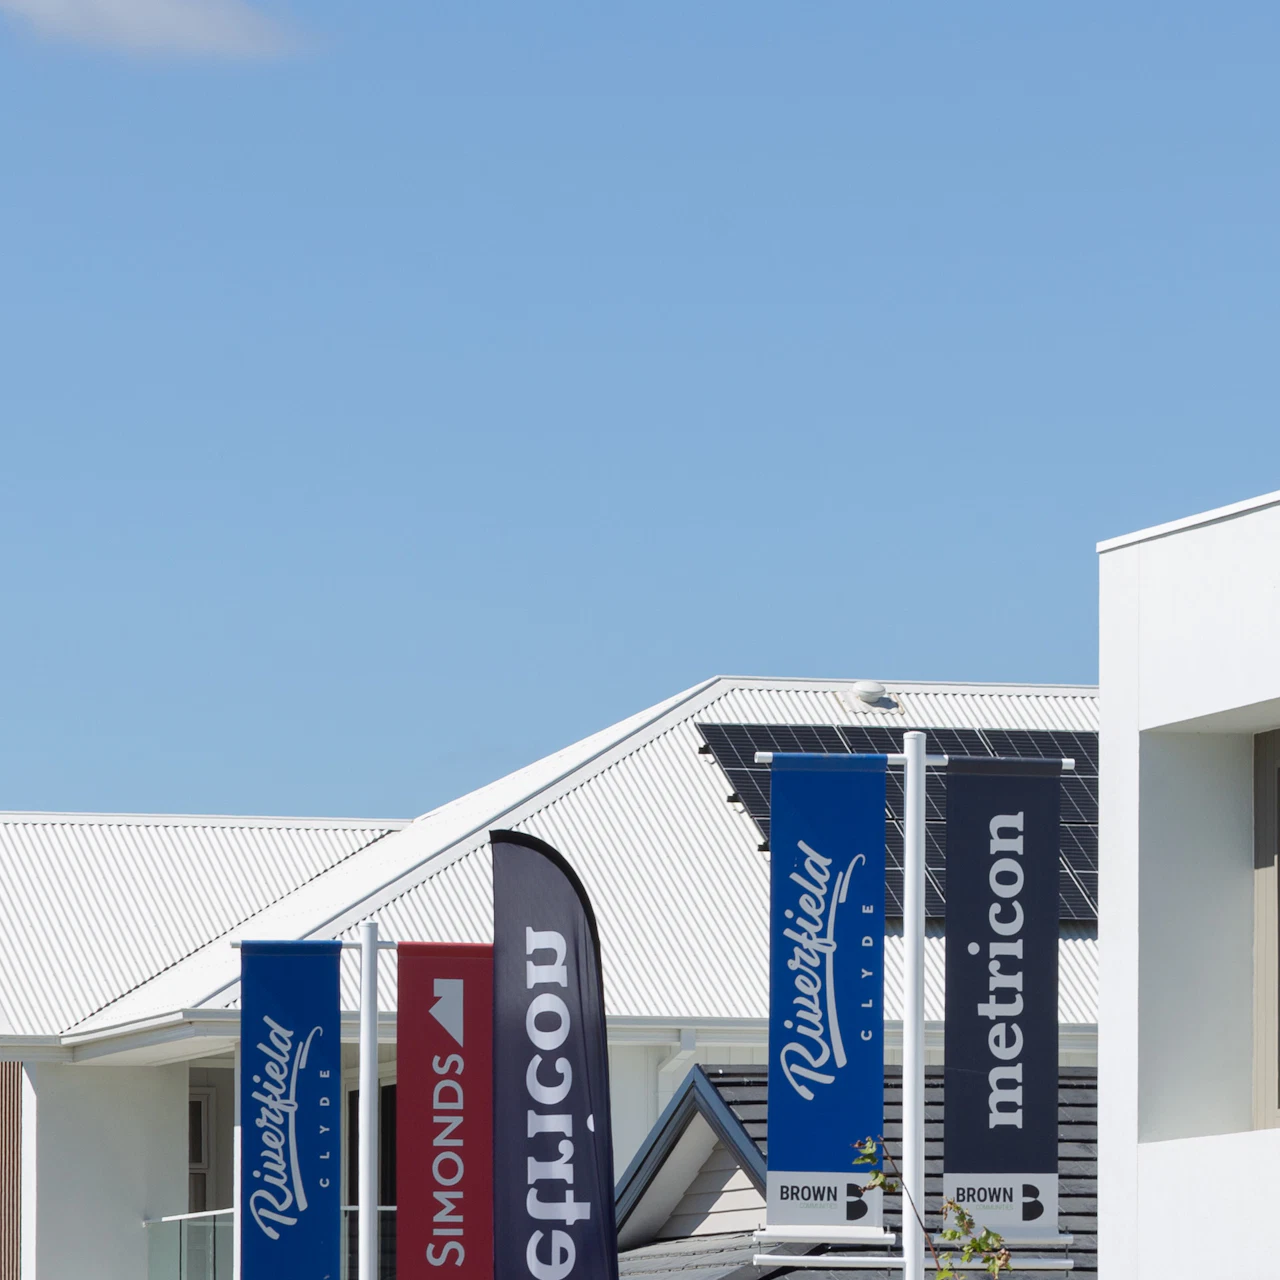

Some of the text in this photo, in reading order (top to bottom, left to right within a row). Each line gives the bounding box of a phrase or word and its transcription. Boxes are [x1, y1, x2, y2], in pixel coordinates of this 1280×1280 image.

[779, 839, 841, 1101] Riverfield
[860, 904, 874, 1041] CLYDE
[968, 811, 1025, 1129] metricon
[250, 1015, 305, 1240] Riverfield
[319, 1070, 330, 1188] CLYDE
[426, 1053, 465, 1267] SIMONDS
[780, 1185, 838, 1201] BROWN
[956, 1187, 1014, 1203] BROWN
